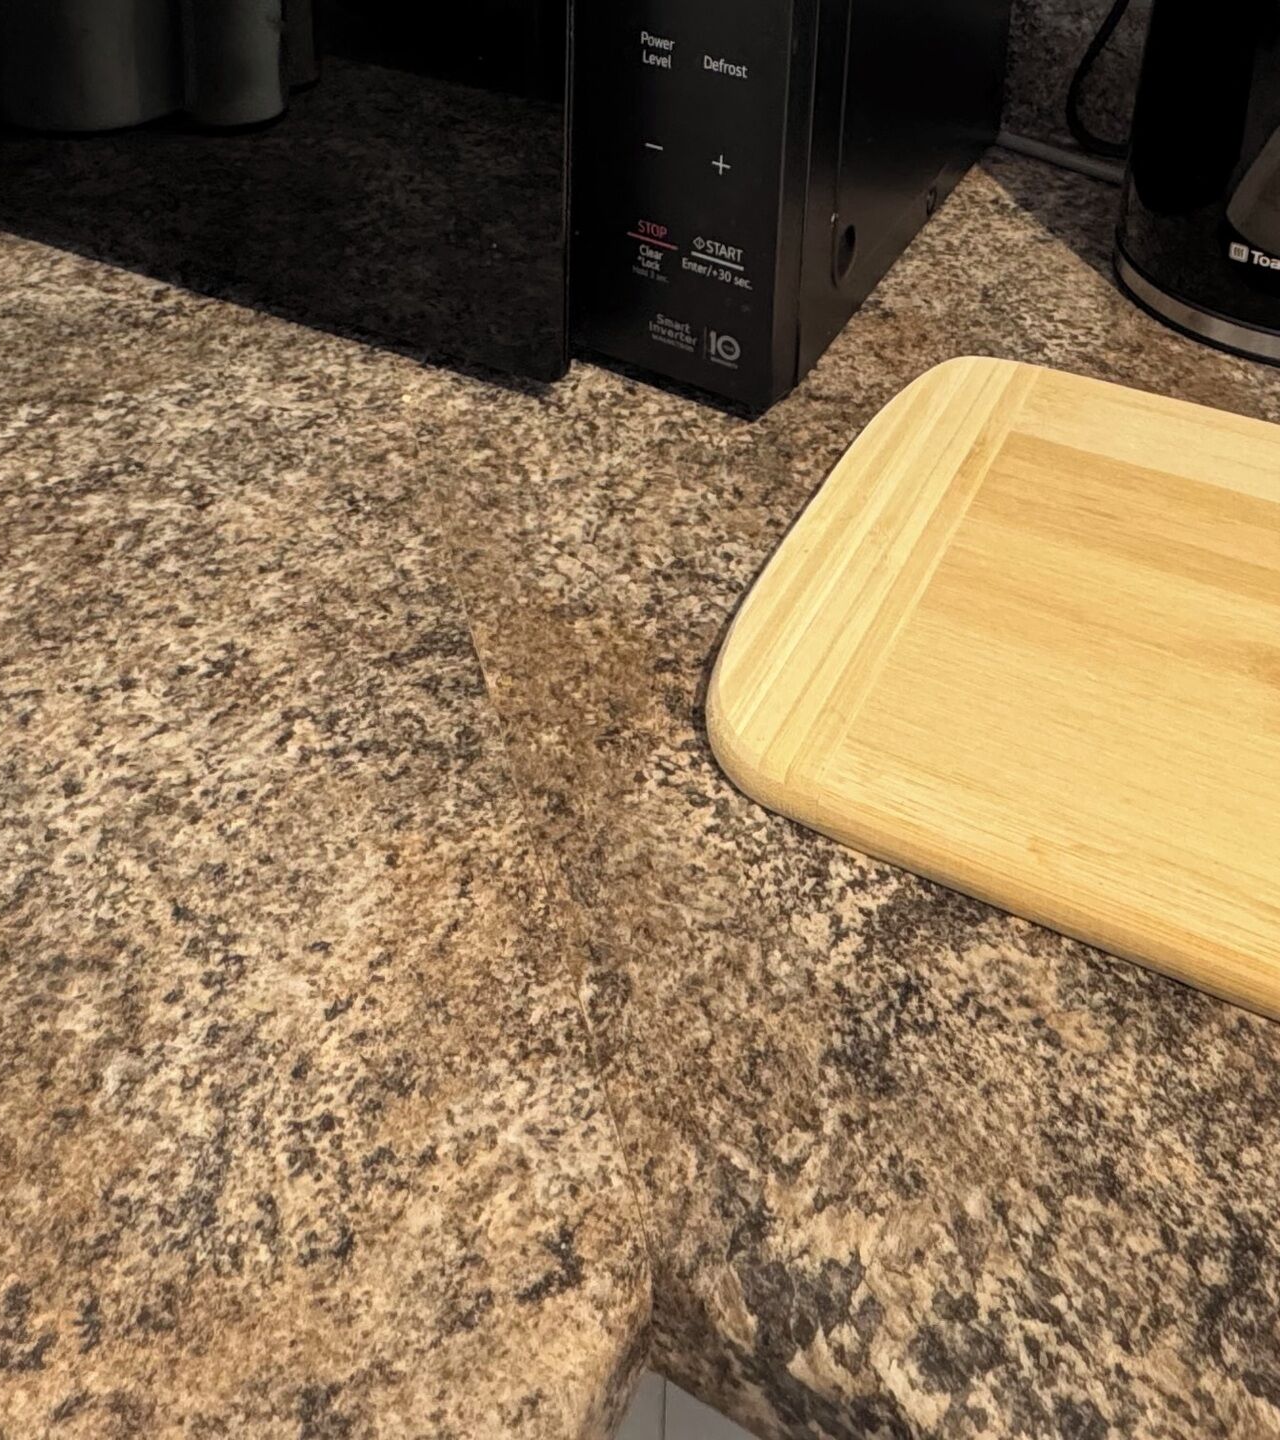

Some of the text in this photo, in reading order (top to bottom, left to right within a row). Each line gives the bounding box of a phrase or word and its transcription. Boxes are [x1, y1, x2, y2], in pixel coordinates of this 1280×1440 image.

[640, 31, 675, 51] Power
[642, 49, 672, 69] Level
[703, 54, 748, 78] Defrost
[637, 220, 668, 238] STOP
[639, 244, 663, 260] Clear
[706, 240, 744, 262] START
[681, 257, 753, 290] Enter/+30 sec.
[649, 320, 698, 346] Inverter
[656, 313, 690, 334] Smart
